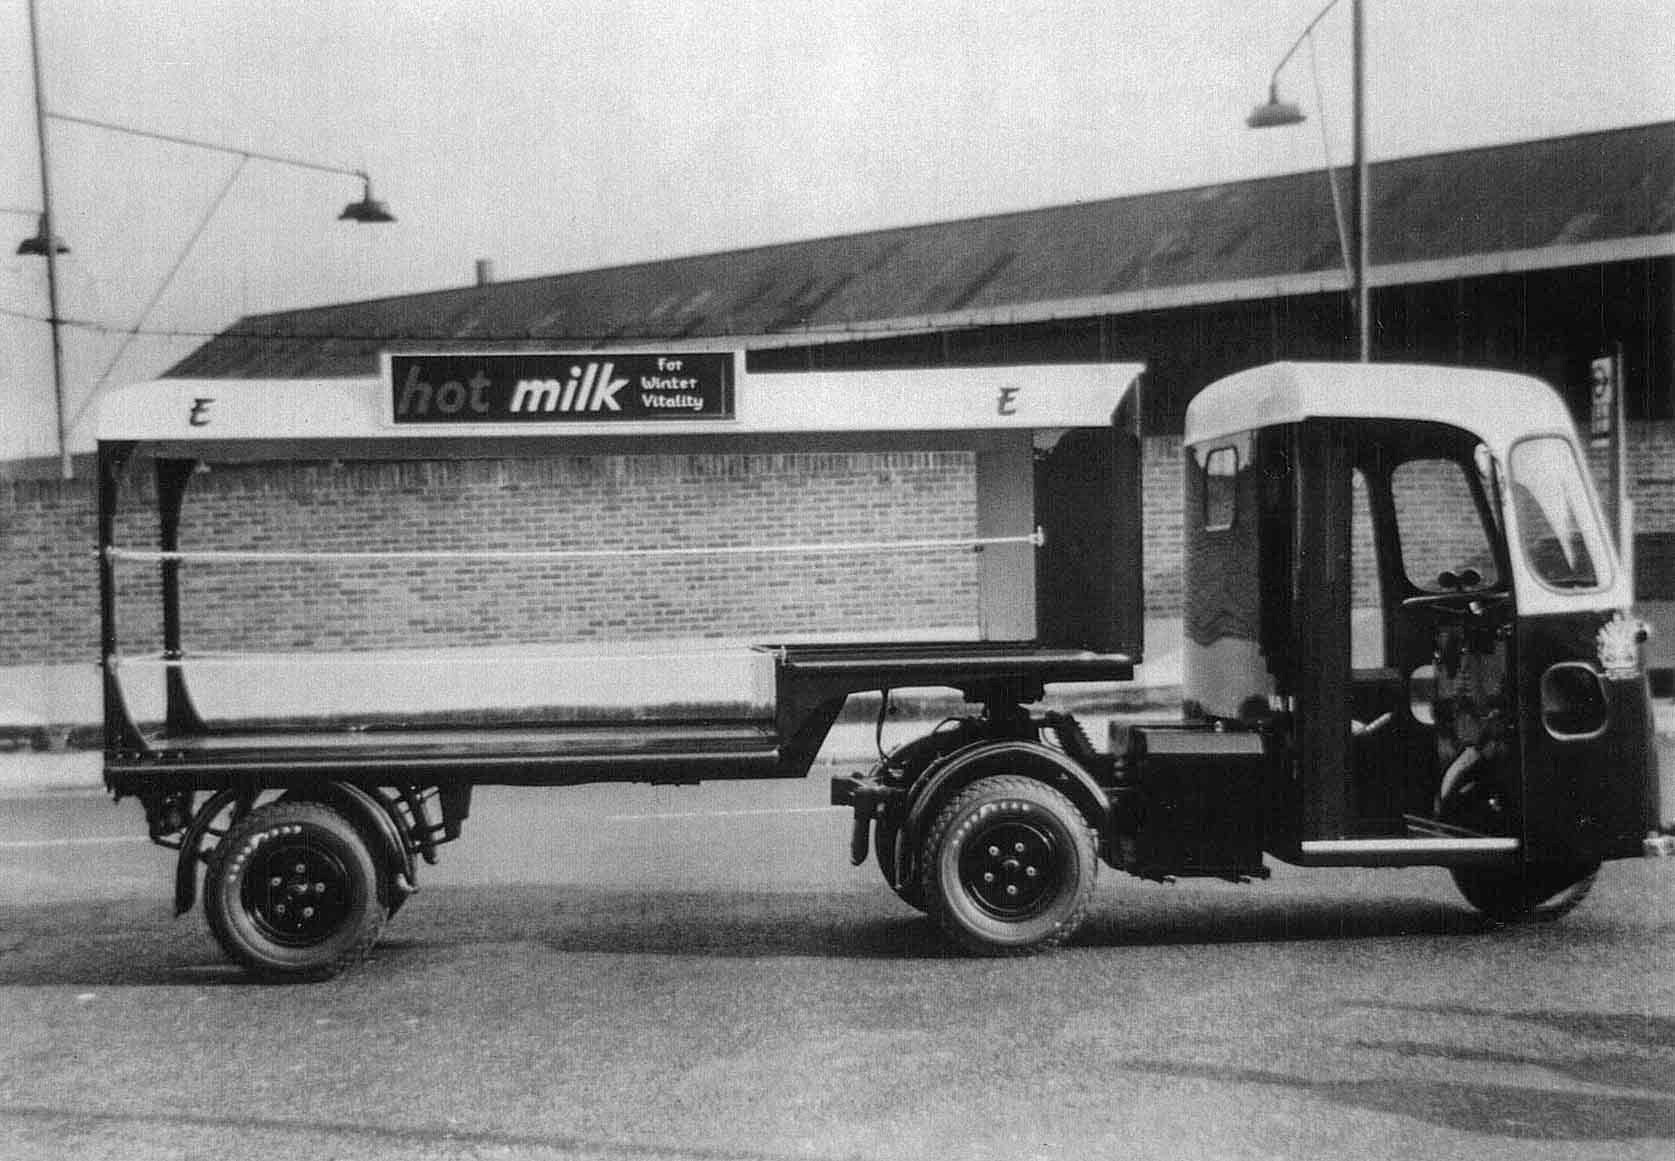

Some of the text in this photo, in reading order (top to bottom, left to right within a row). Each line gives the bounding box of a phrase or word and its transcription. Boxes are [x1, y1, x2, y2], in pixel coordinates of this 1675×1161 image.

[657, 357, 683, 372] For
[398, 362, 630, 415] hot milk
[641, 376, 699, 389] Winter
[190, 398, 216, 427] E
[641, 393, 704, 411] Vitality
[998, 387, 1021, 416] E
